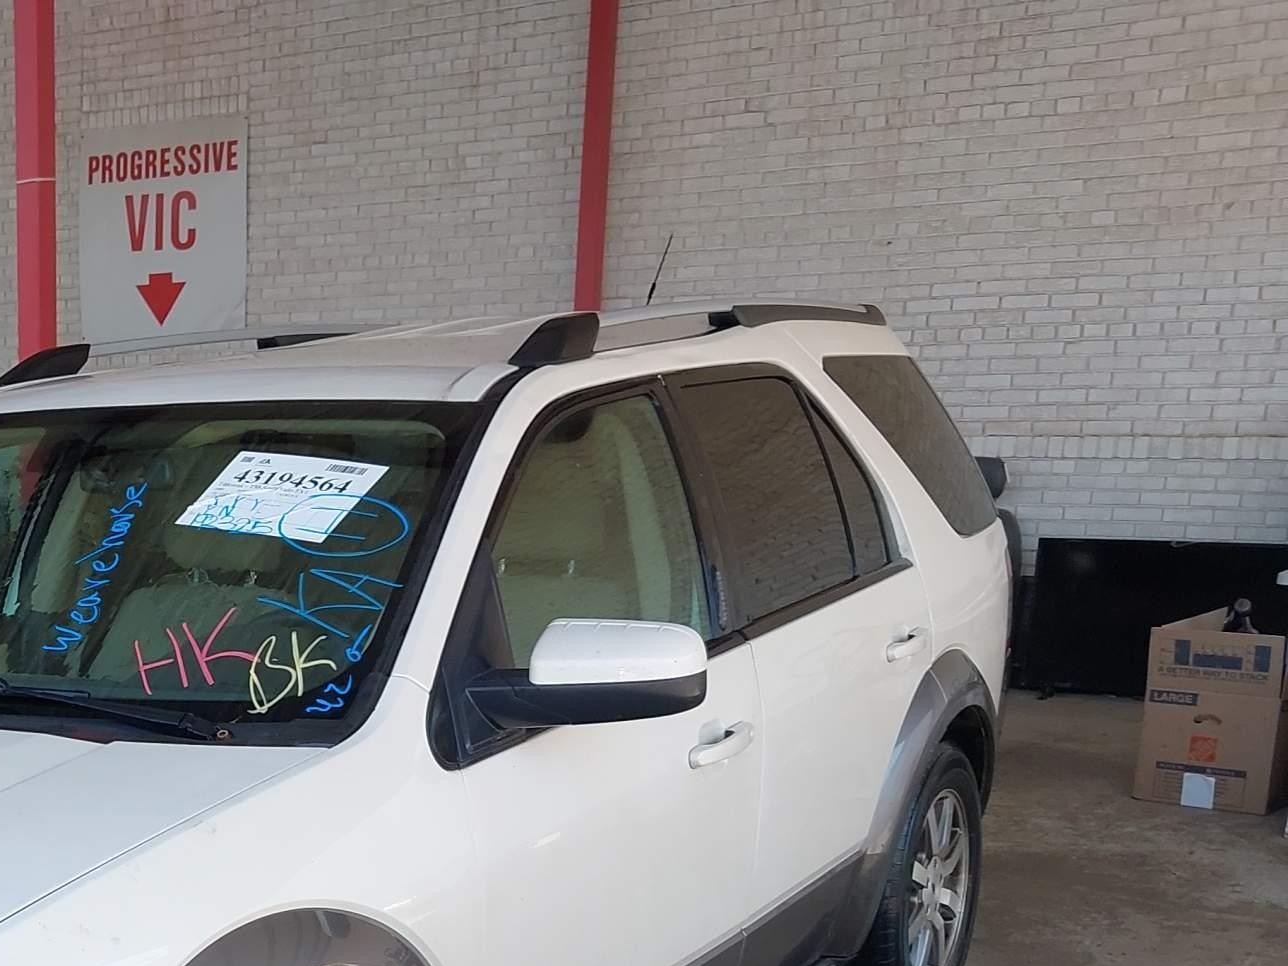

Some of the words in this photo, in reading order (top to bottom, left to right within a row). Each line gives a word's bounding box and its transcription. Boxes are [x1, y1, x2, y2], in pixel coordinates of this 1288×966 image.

[88, 140, 239, 185] PROGRESSIVE
[124, 191, 197, 252] VIC
[233, 468, 353, 494] 43194564
[134, 607, 262, 695] HK
[1153, 691, 1193, 704] LARGE
